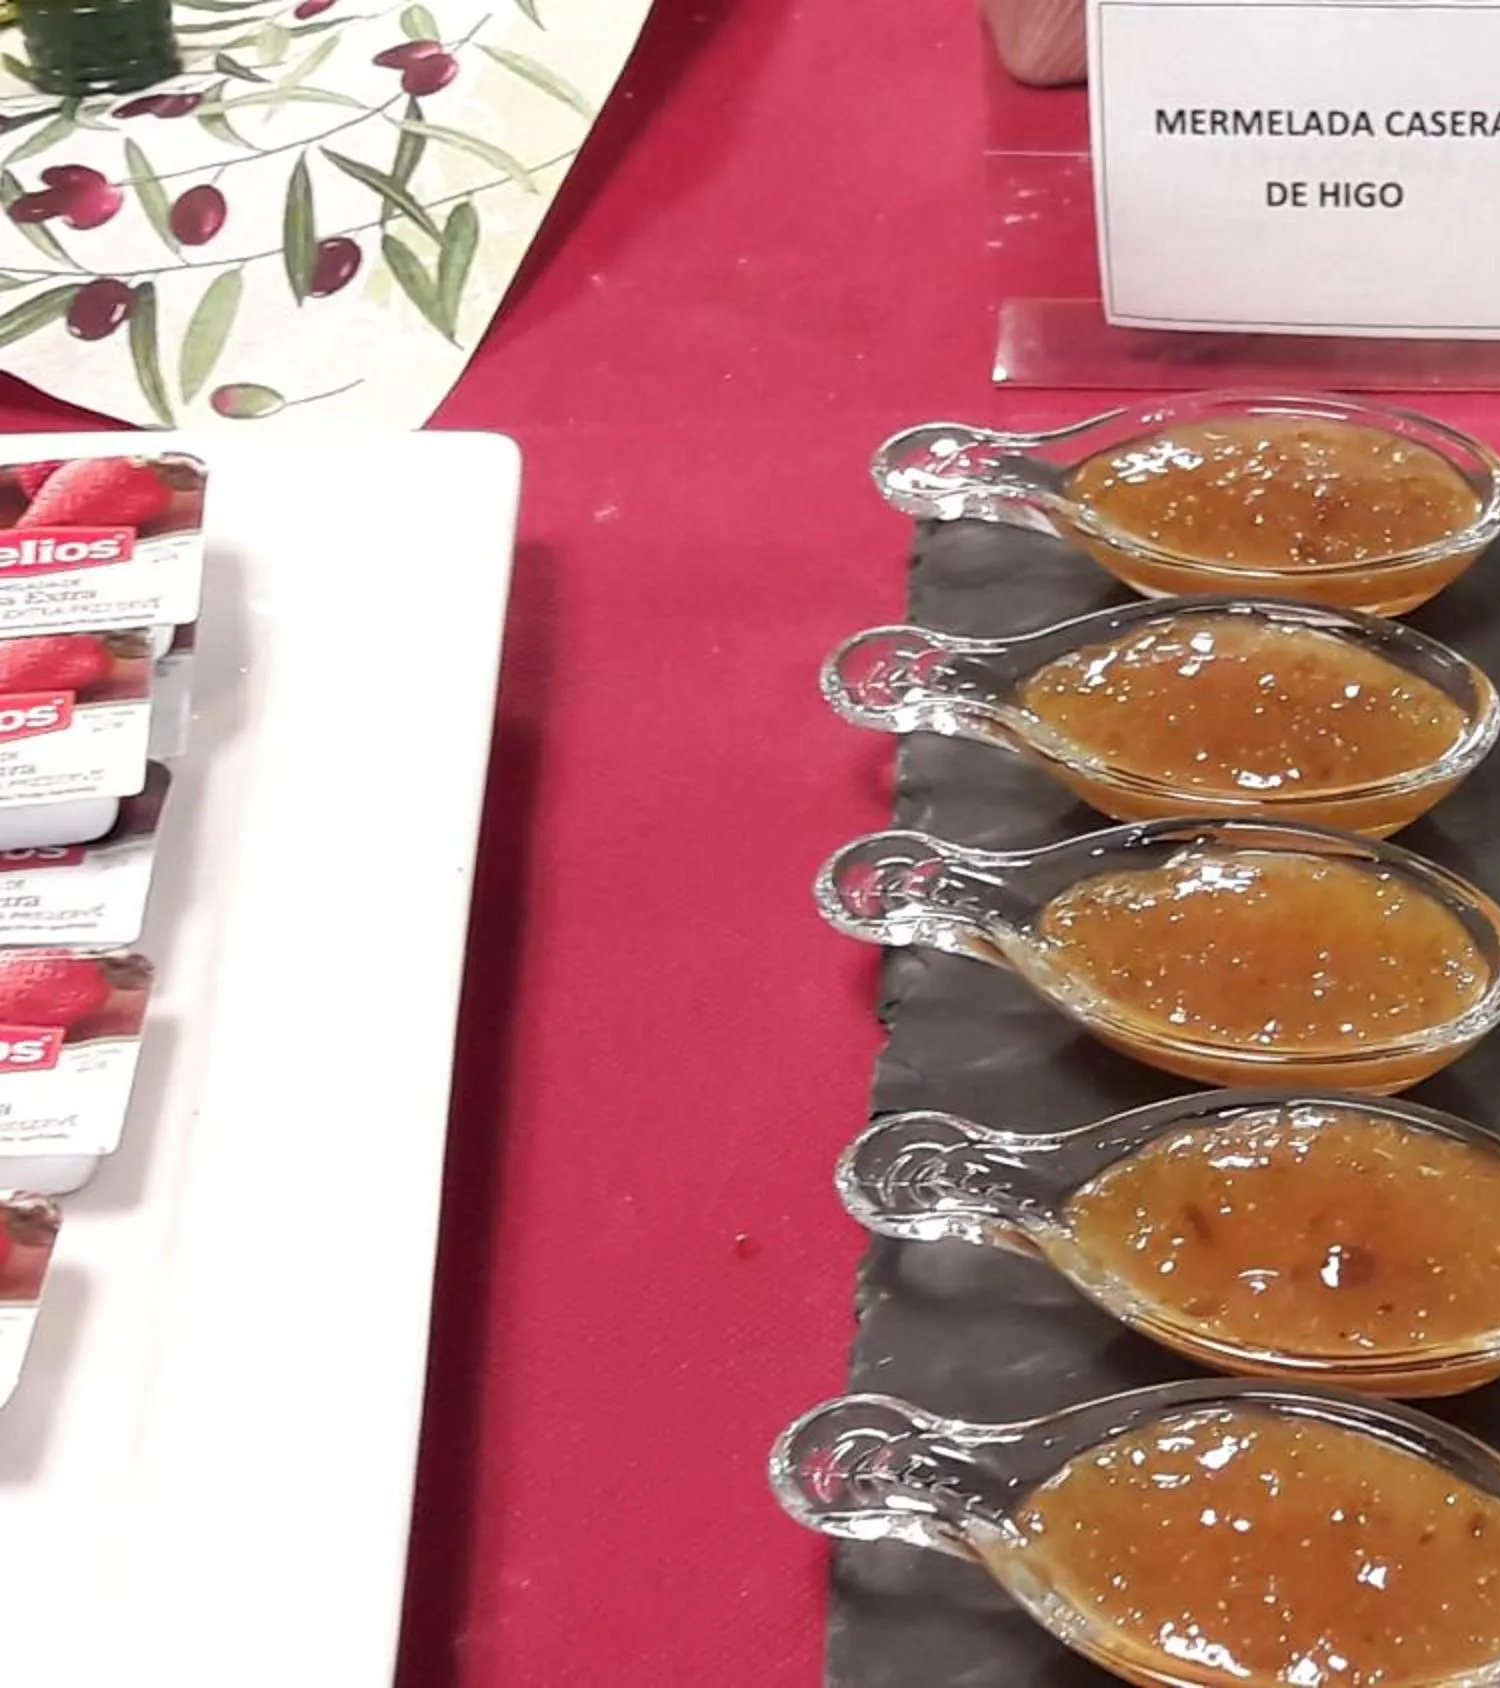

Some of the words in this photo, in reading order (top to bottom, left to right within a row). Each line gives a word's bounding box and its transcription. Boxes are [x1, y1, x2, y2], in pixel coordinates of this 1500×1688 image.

[1154, 108, 1374, 137] MERMELADA
[1265, 181, 1308, 208] DE
[1318, 182, 1404, 209] HIGO
